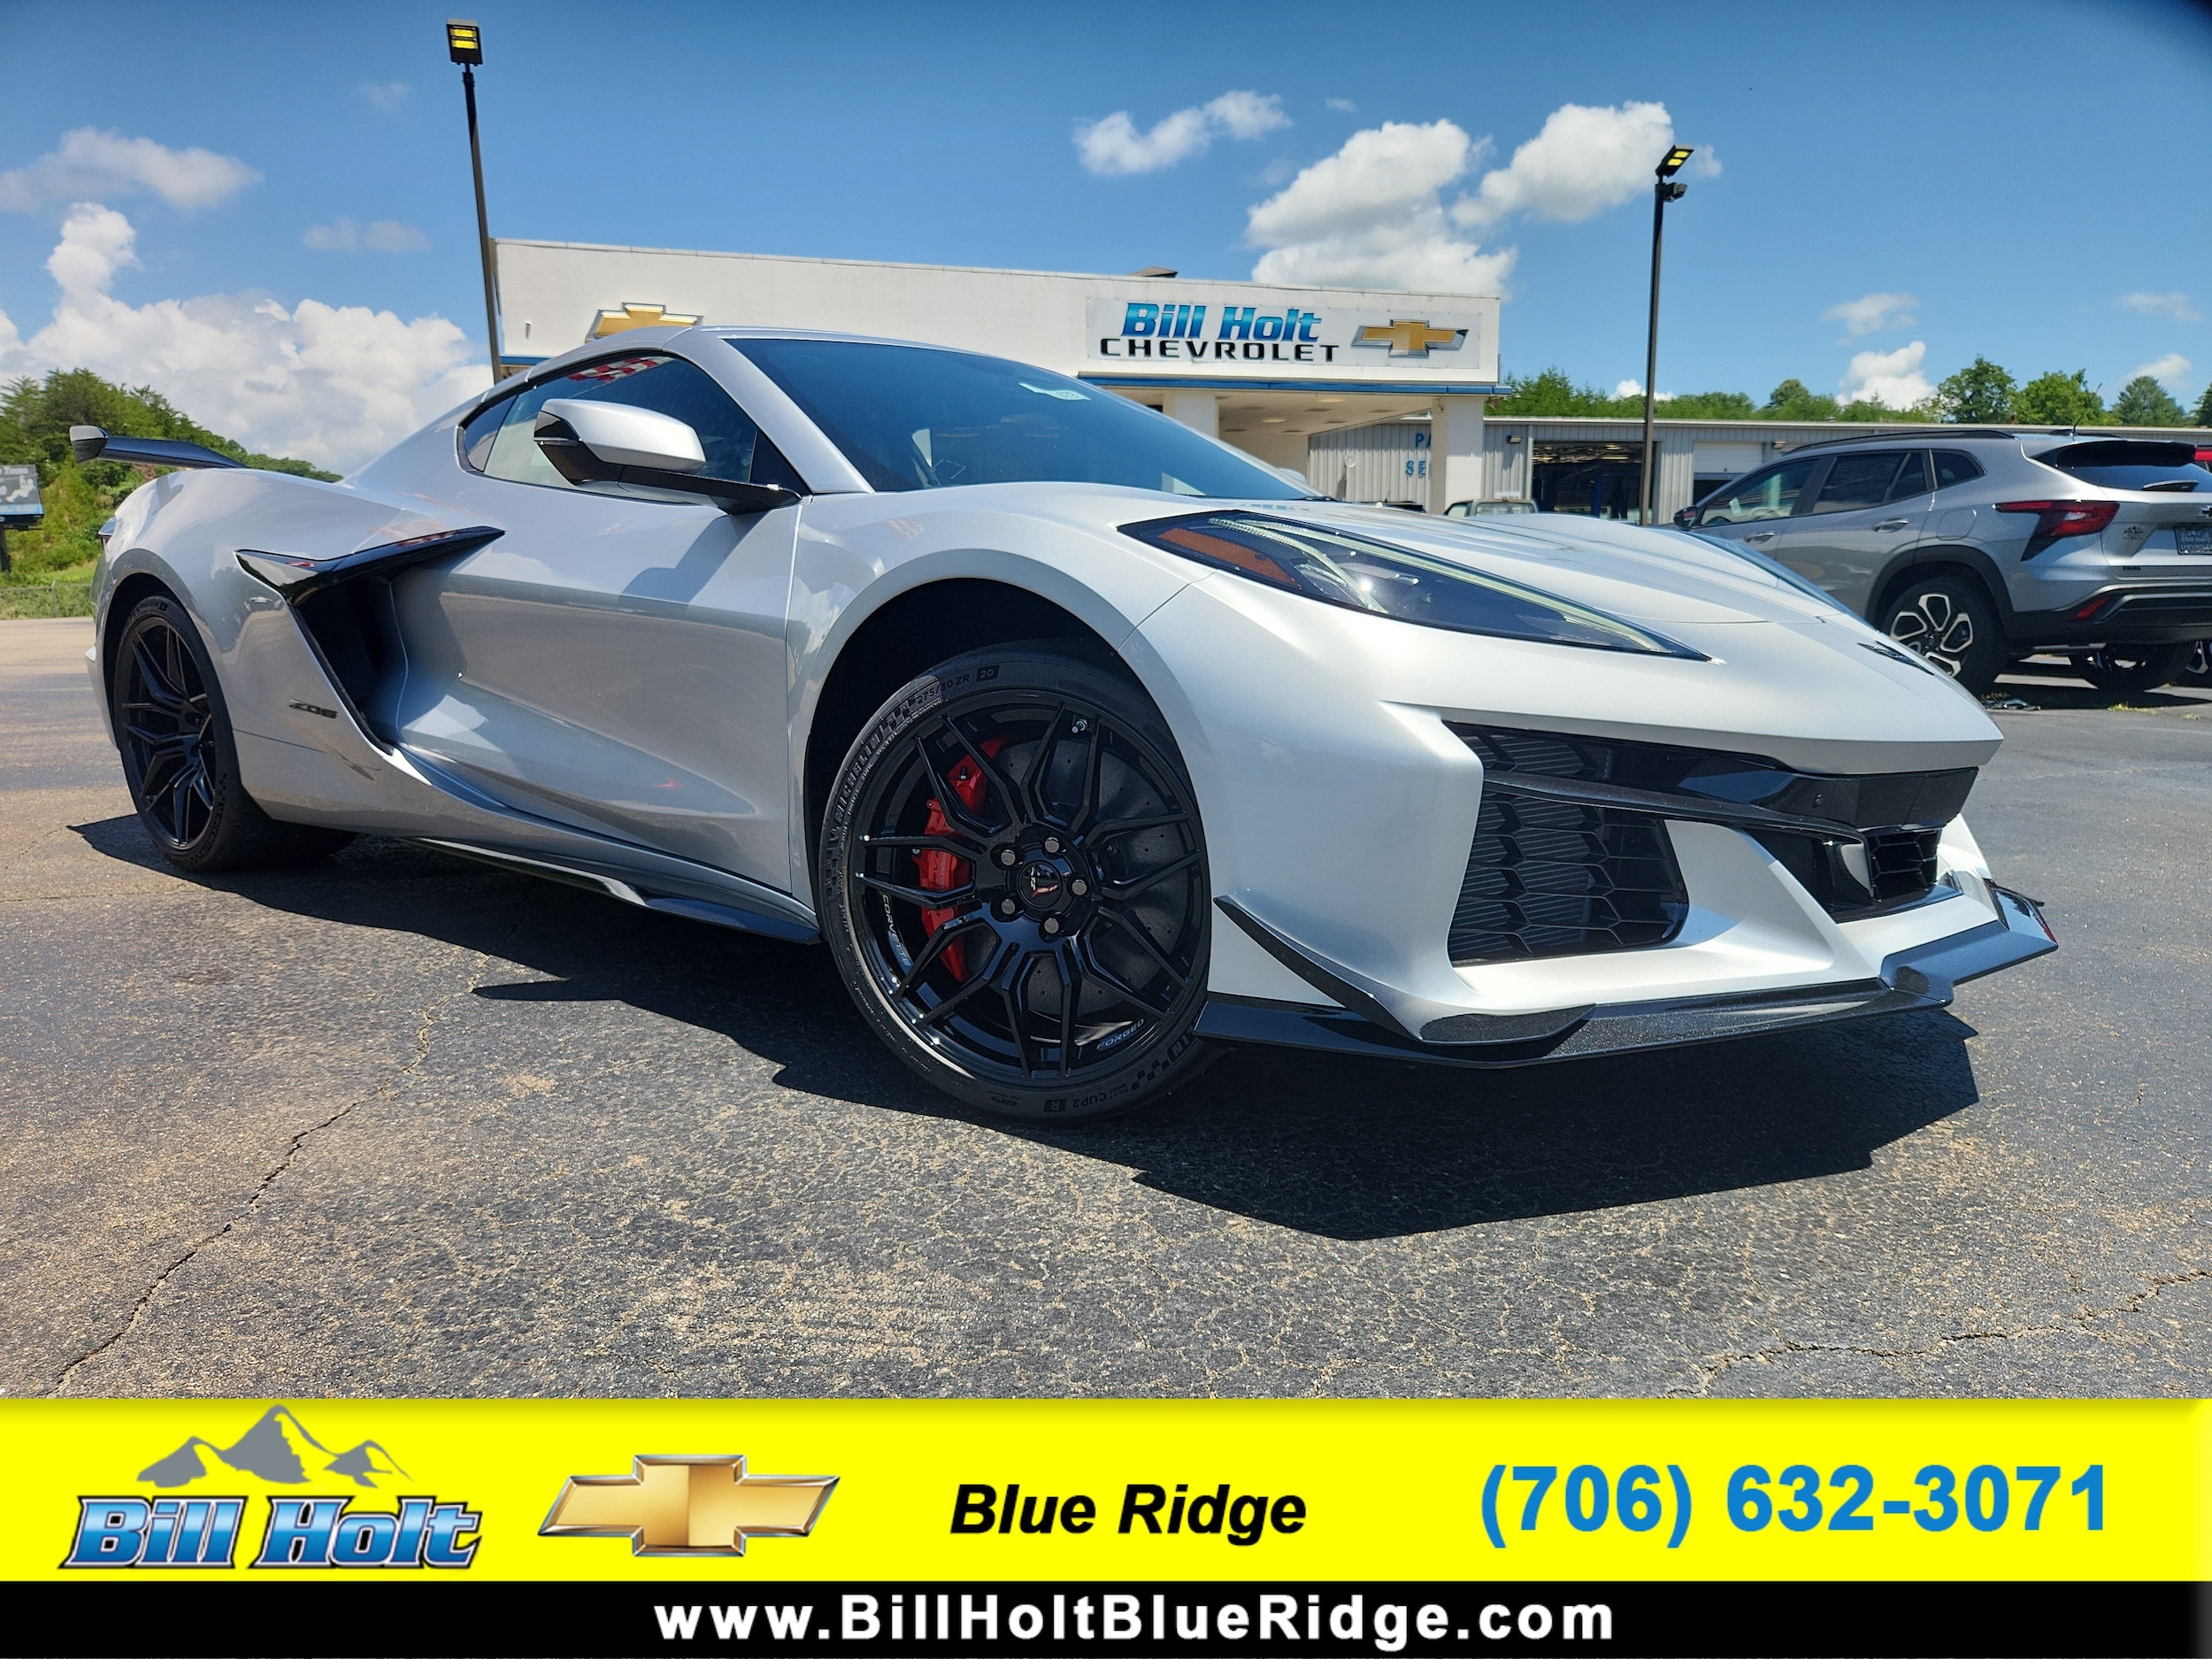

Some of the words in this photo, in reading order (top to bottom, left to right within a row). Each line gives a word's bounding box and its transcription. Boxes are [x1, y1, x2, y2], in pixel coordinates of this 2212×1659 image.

[1121, 302, 1207, 339] Bill
[1217, 306, 1322, 342] Holt
[1100, 337, 1340, 363] CHEVROLET
[916, 680, 954, 705] 275/30
[979, 668, 995, 680] 20
[288, 698, 338, 719] Z06
[833, 733, 882, 826] MICHELIN
[882, 895, 912, 967] CORVETTE
[1096, 1018, 1145, 1050] FORGED
